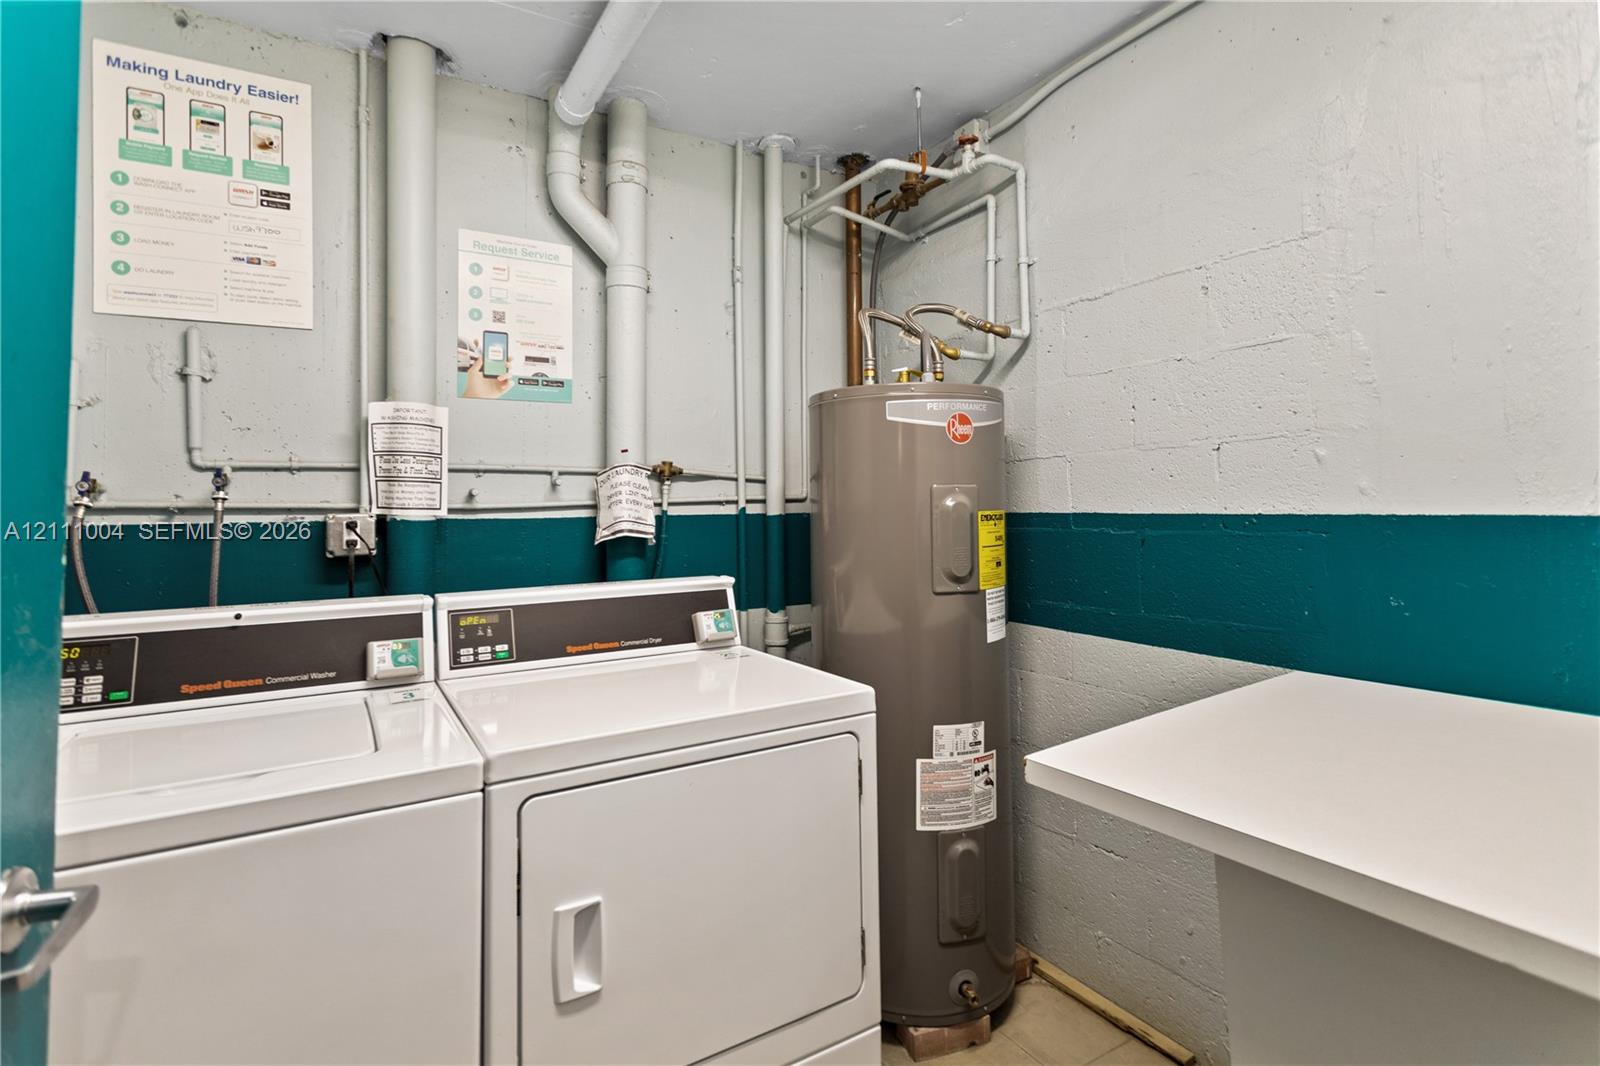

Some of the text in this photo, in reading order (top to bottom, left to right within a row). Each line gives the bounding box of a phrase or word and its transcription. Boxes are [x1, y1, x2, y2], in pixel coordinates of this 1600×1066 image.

[106, 55, 300, 105] Making Laundry Easier!
[163, 82, 183, 94] One
[186, 86, 205, 98] App
[206, 89, 230, 102] Does
[117, 173, 122, 182] 1
[115, 202, 124, 212] 2
[116, 232, 125, 242] 3
[473, 240, 518, 256] Request
[521, 247, 560, 262] Service
[116, 263, 125, 273] 4
[927, 402, 988, 412] PERFORMANCE
[949, 412, 972, 440] Rheem
[611, 468, 644, 479] LAUNDRY
[610, 481, 650, 493] PLEASE CLEAN
[625, 498, 643, 507] EVERY
[566, 636, 663, 655] Speed Queen Commercial Dryer
[180, 670, 337, 695] Speed Queen Commercial Washer
